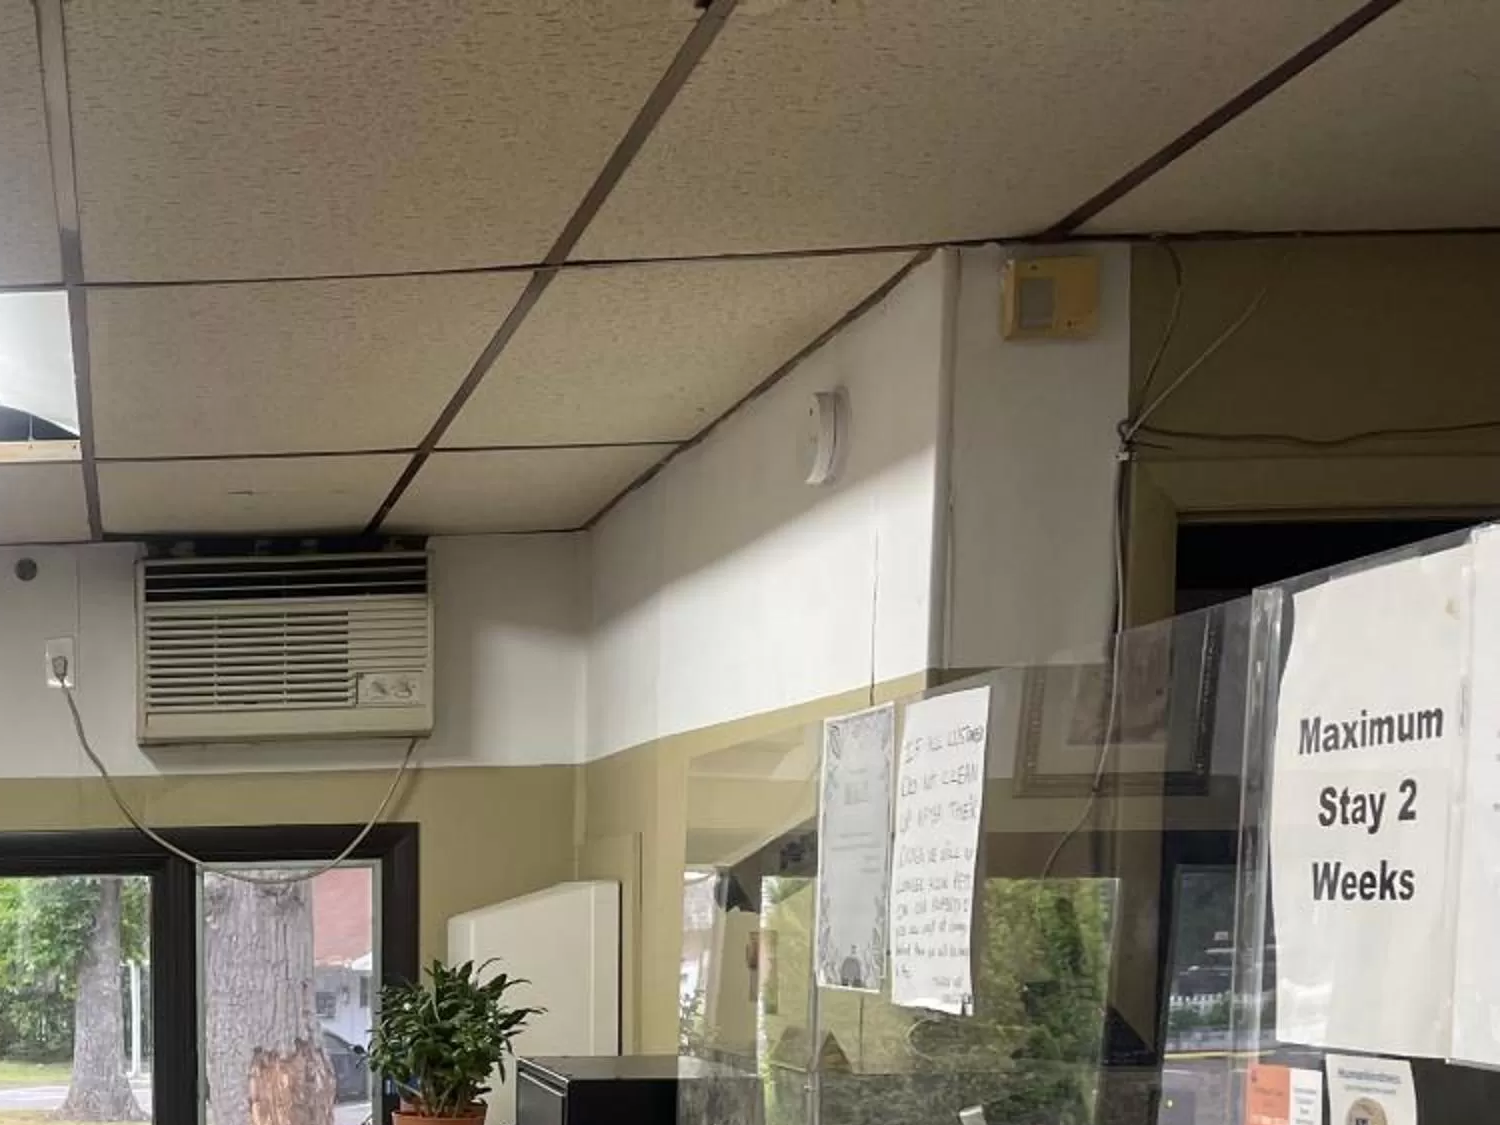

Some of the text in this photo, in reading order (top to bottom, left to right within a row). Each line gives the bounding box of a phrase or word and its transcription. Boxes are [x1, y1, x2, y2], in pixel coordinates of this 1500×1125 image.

[1299, 706, 1444, 755] Maximum
[1318, 778, 1417, 834] Stay 2
[1312, 860, 1416, 901] Weeks
